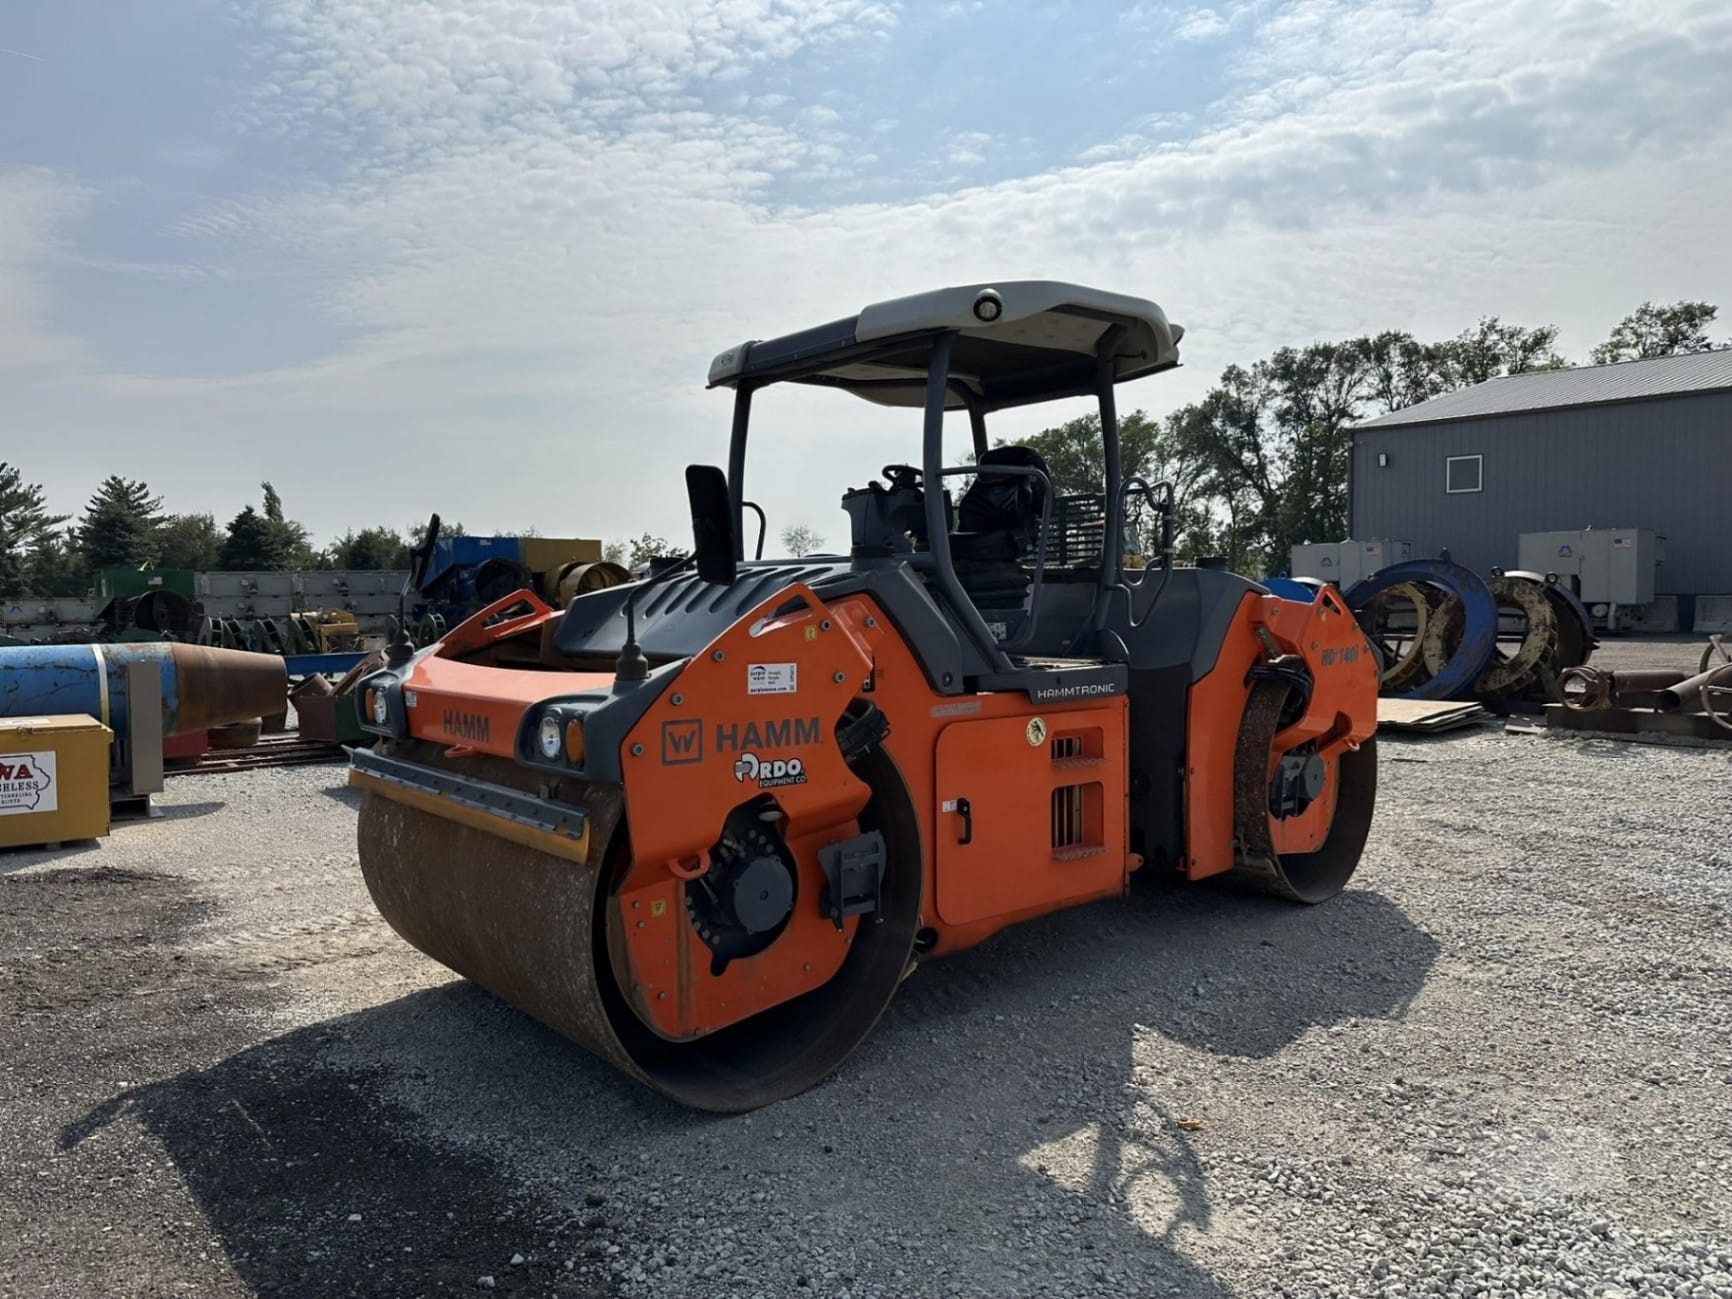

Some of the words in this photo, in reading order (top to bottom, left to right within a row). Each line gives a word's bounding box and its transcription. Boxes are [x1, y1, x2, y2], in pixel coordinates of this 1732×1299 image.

[1037, 683, 1115, 699] HAMMTRONIC
[443, 709, 489, 743] HAMM
[716, 717, 820, 752] HAMM
[760, 777, 795, 788] EQUIPMENT
